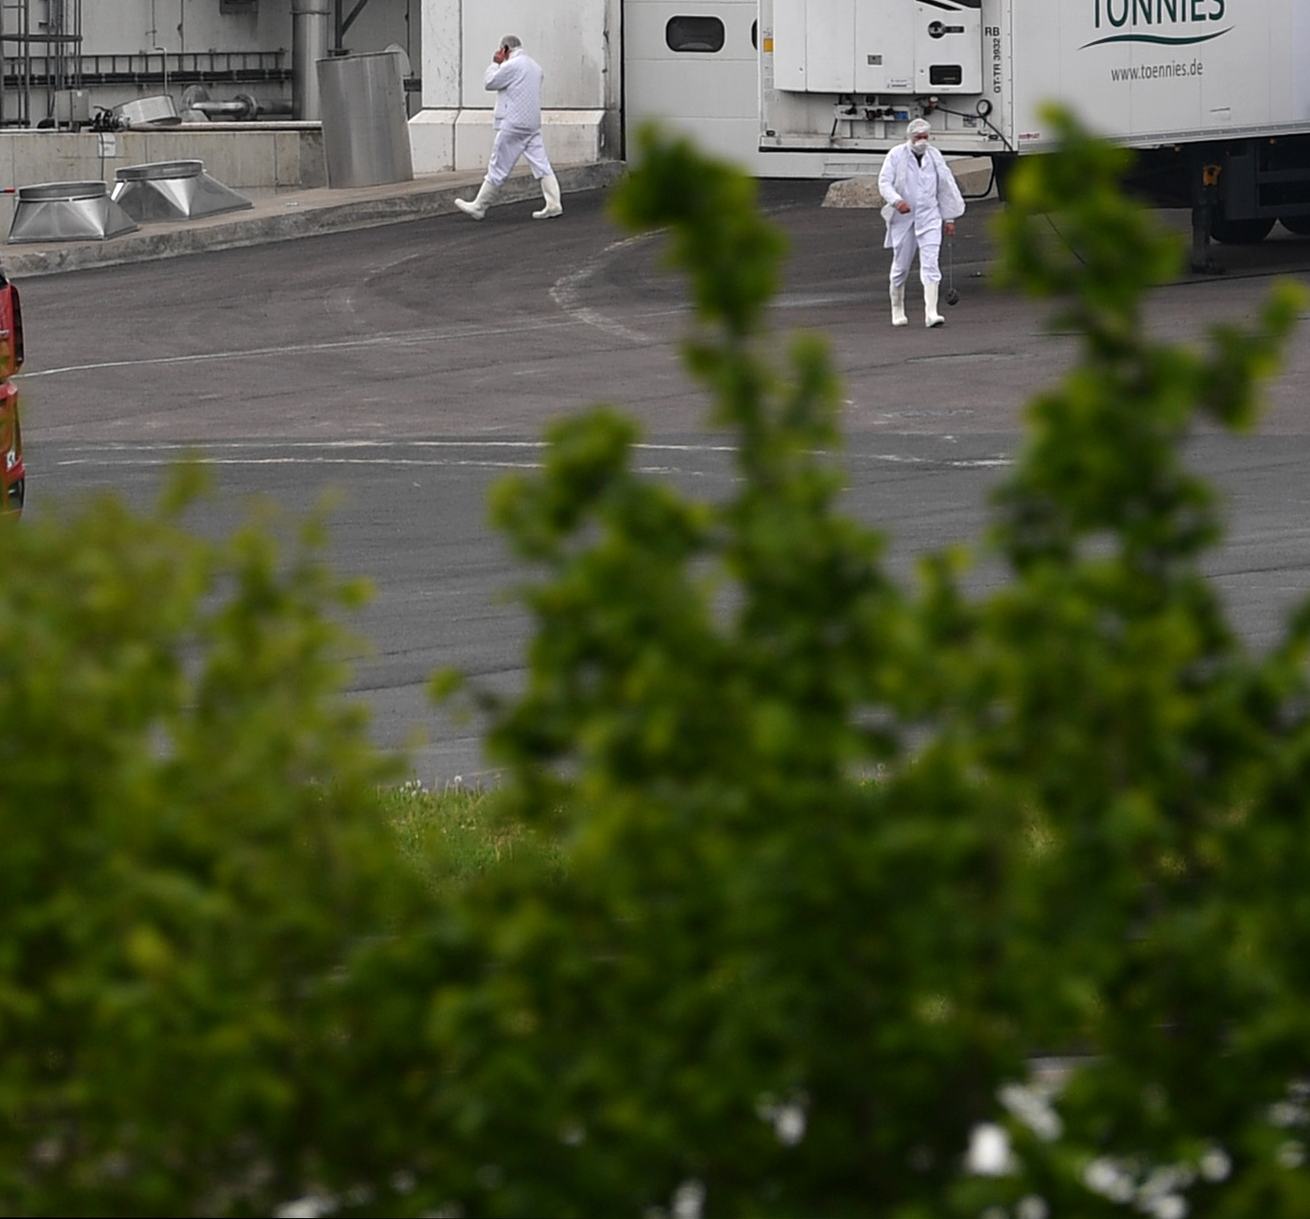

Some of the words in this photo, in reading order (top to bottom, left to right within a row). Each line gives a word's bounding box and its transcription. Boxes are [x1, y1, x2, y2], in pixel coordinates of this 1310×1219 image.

[985, 27, 1000, 36] RB
[993, 38, 1001, 60] 3932
[1111, 58, 1203, 81] www.toennies.de
